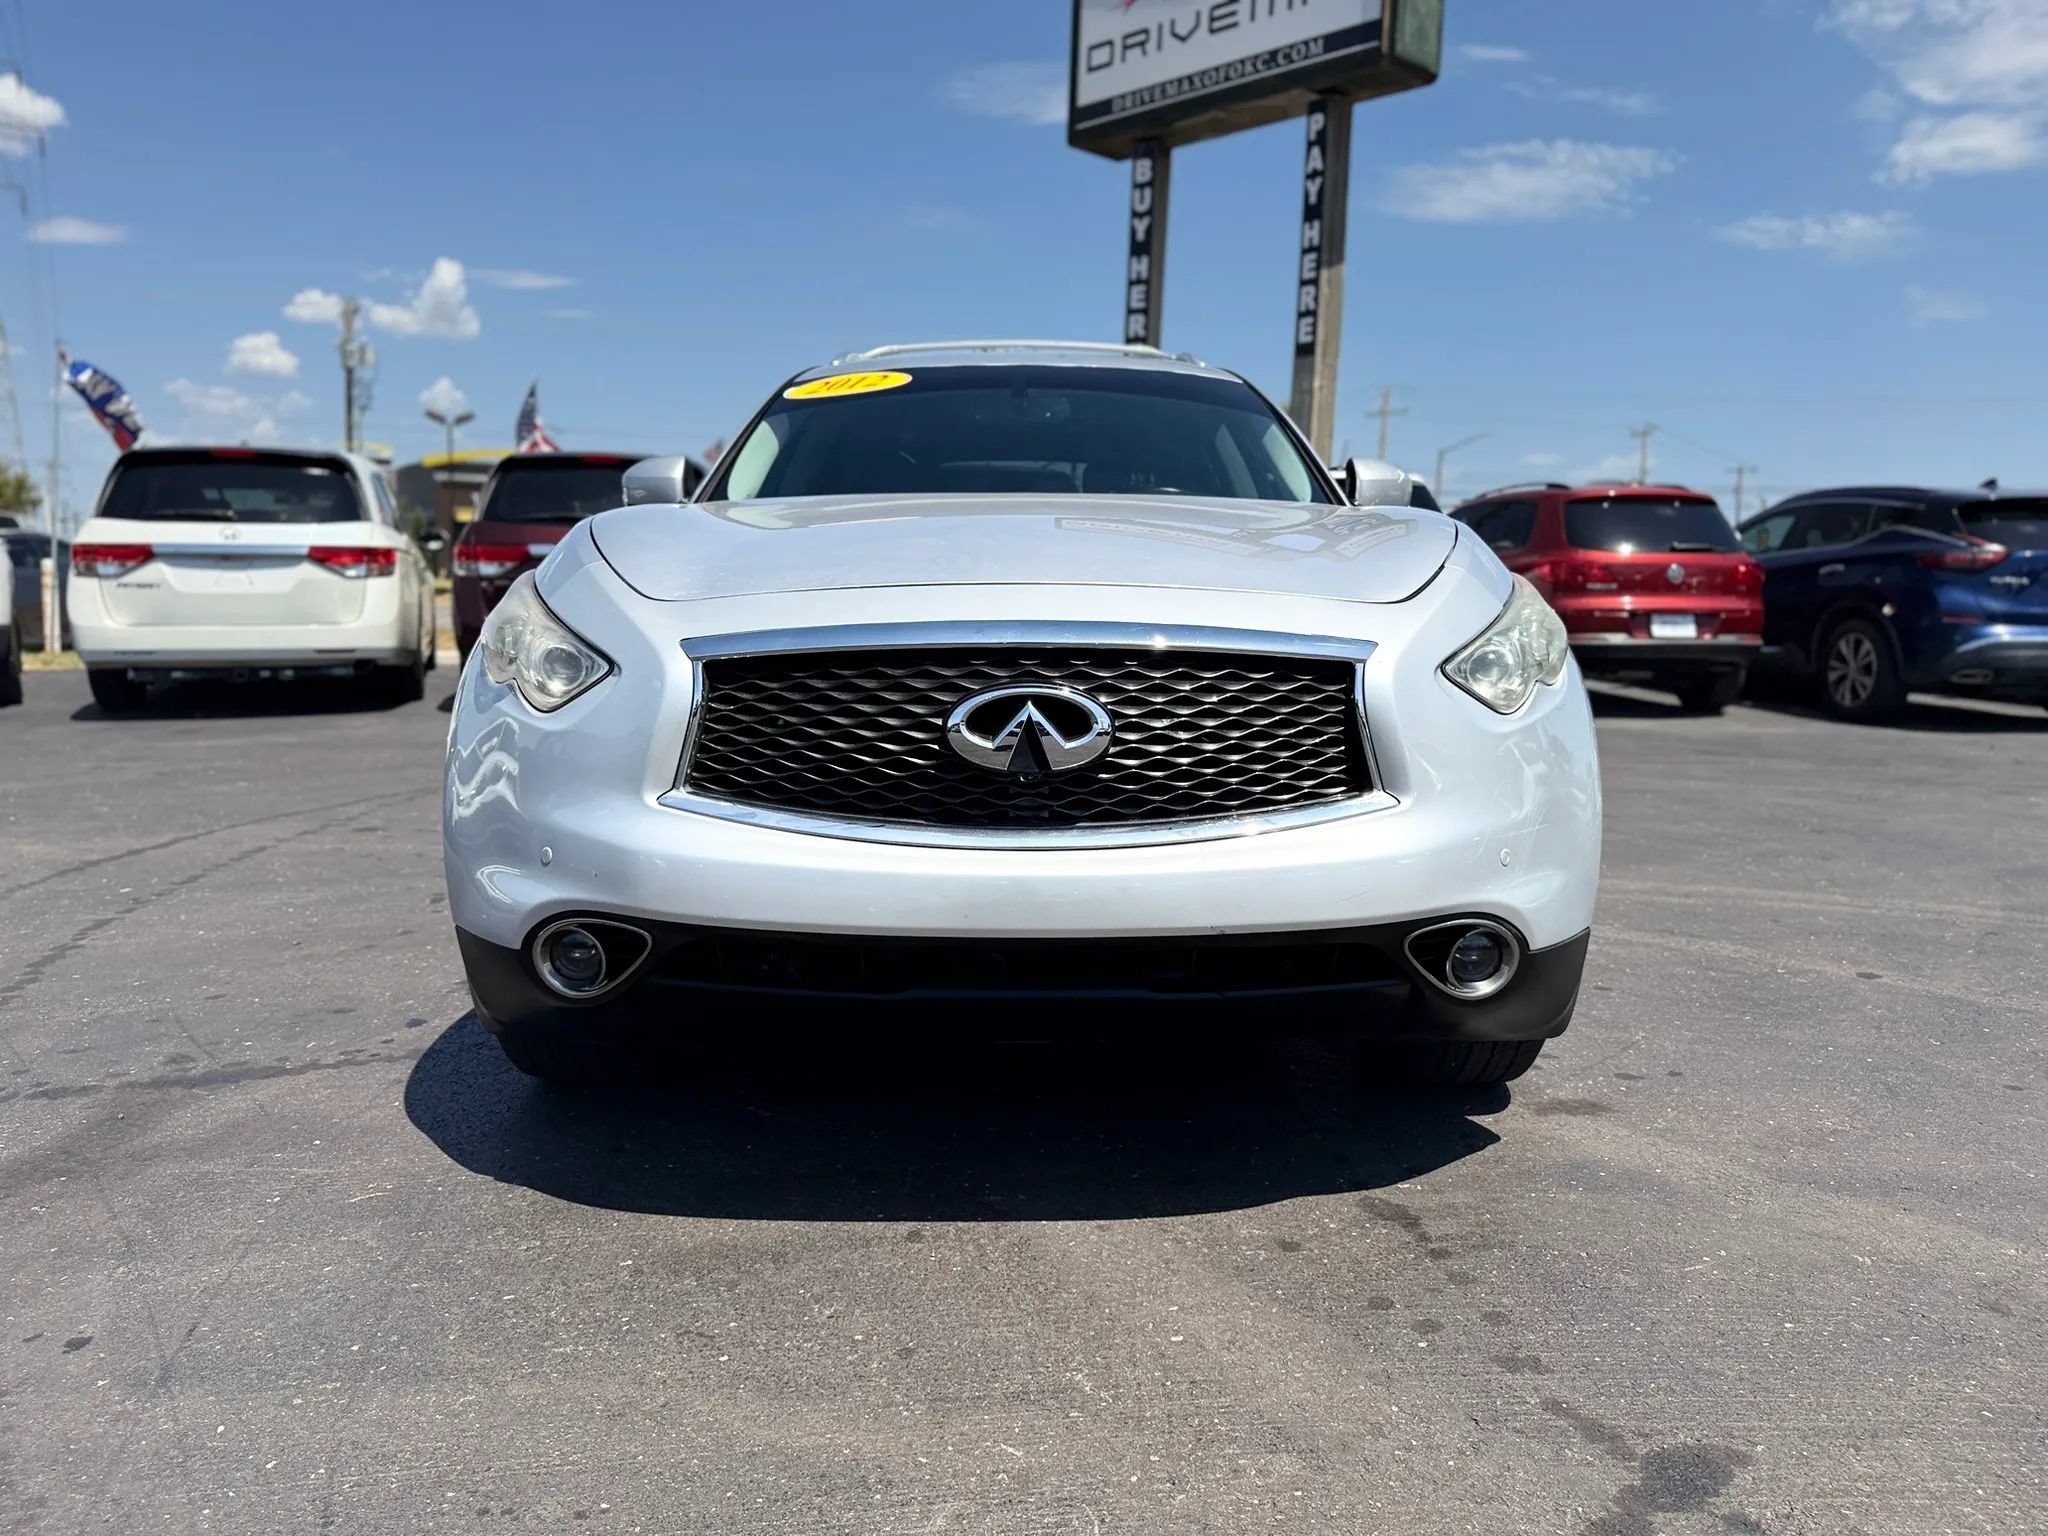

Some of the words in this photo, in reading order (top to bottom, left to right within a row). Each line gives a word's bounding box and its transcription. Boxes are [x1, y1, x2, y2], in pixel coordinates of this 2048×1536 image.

[1111, 37, 1325, 114] DRIVEMAXOFOKC.COM
[1132, 157, 1152, 243] BUY
[1306, 112, 1325, 205] PAY
[1127, 253, 1150, 340] HER
[1298, 219, 1321, 344] HERE
[803, 374, 890, 395] 2012
